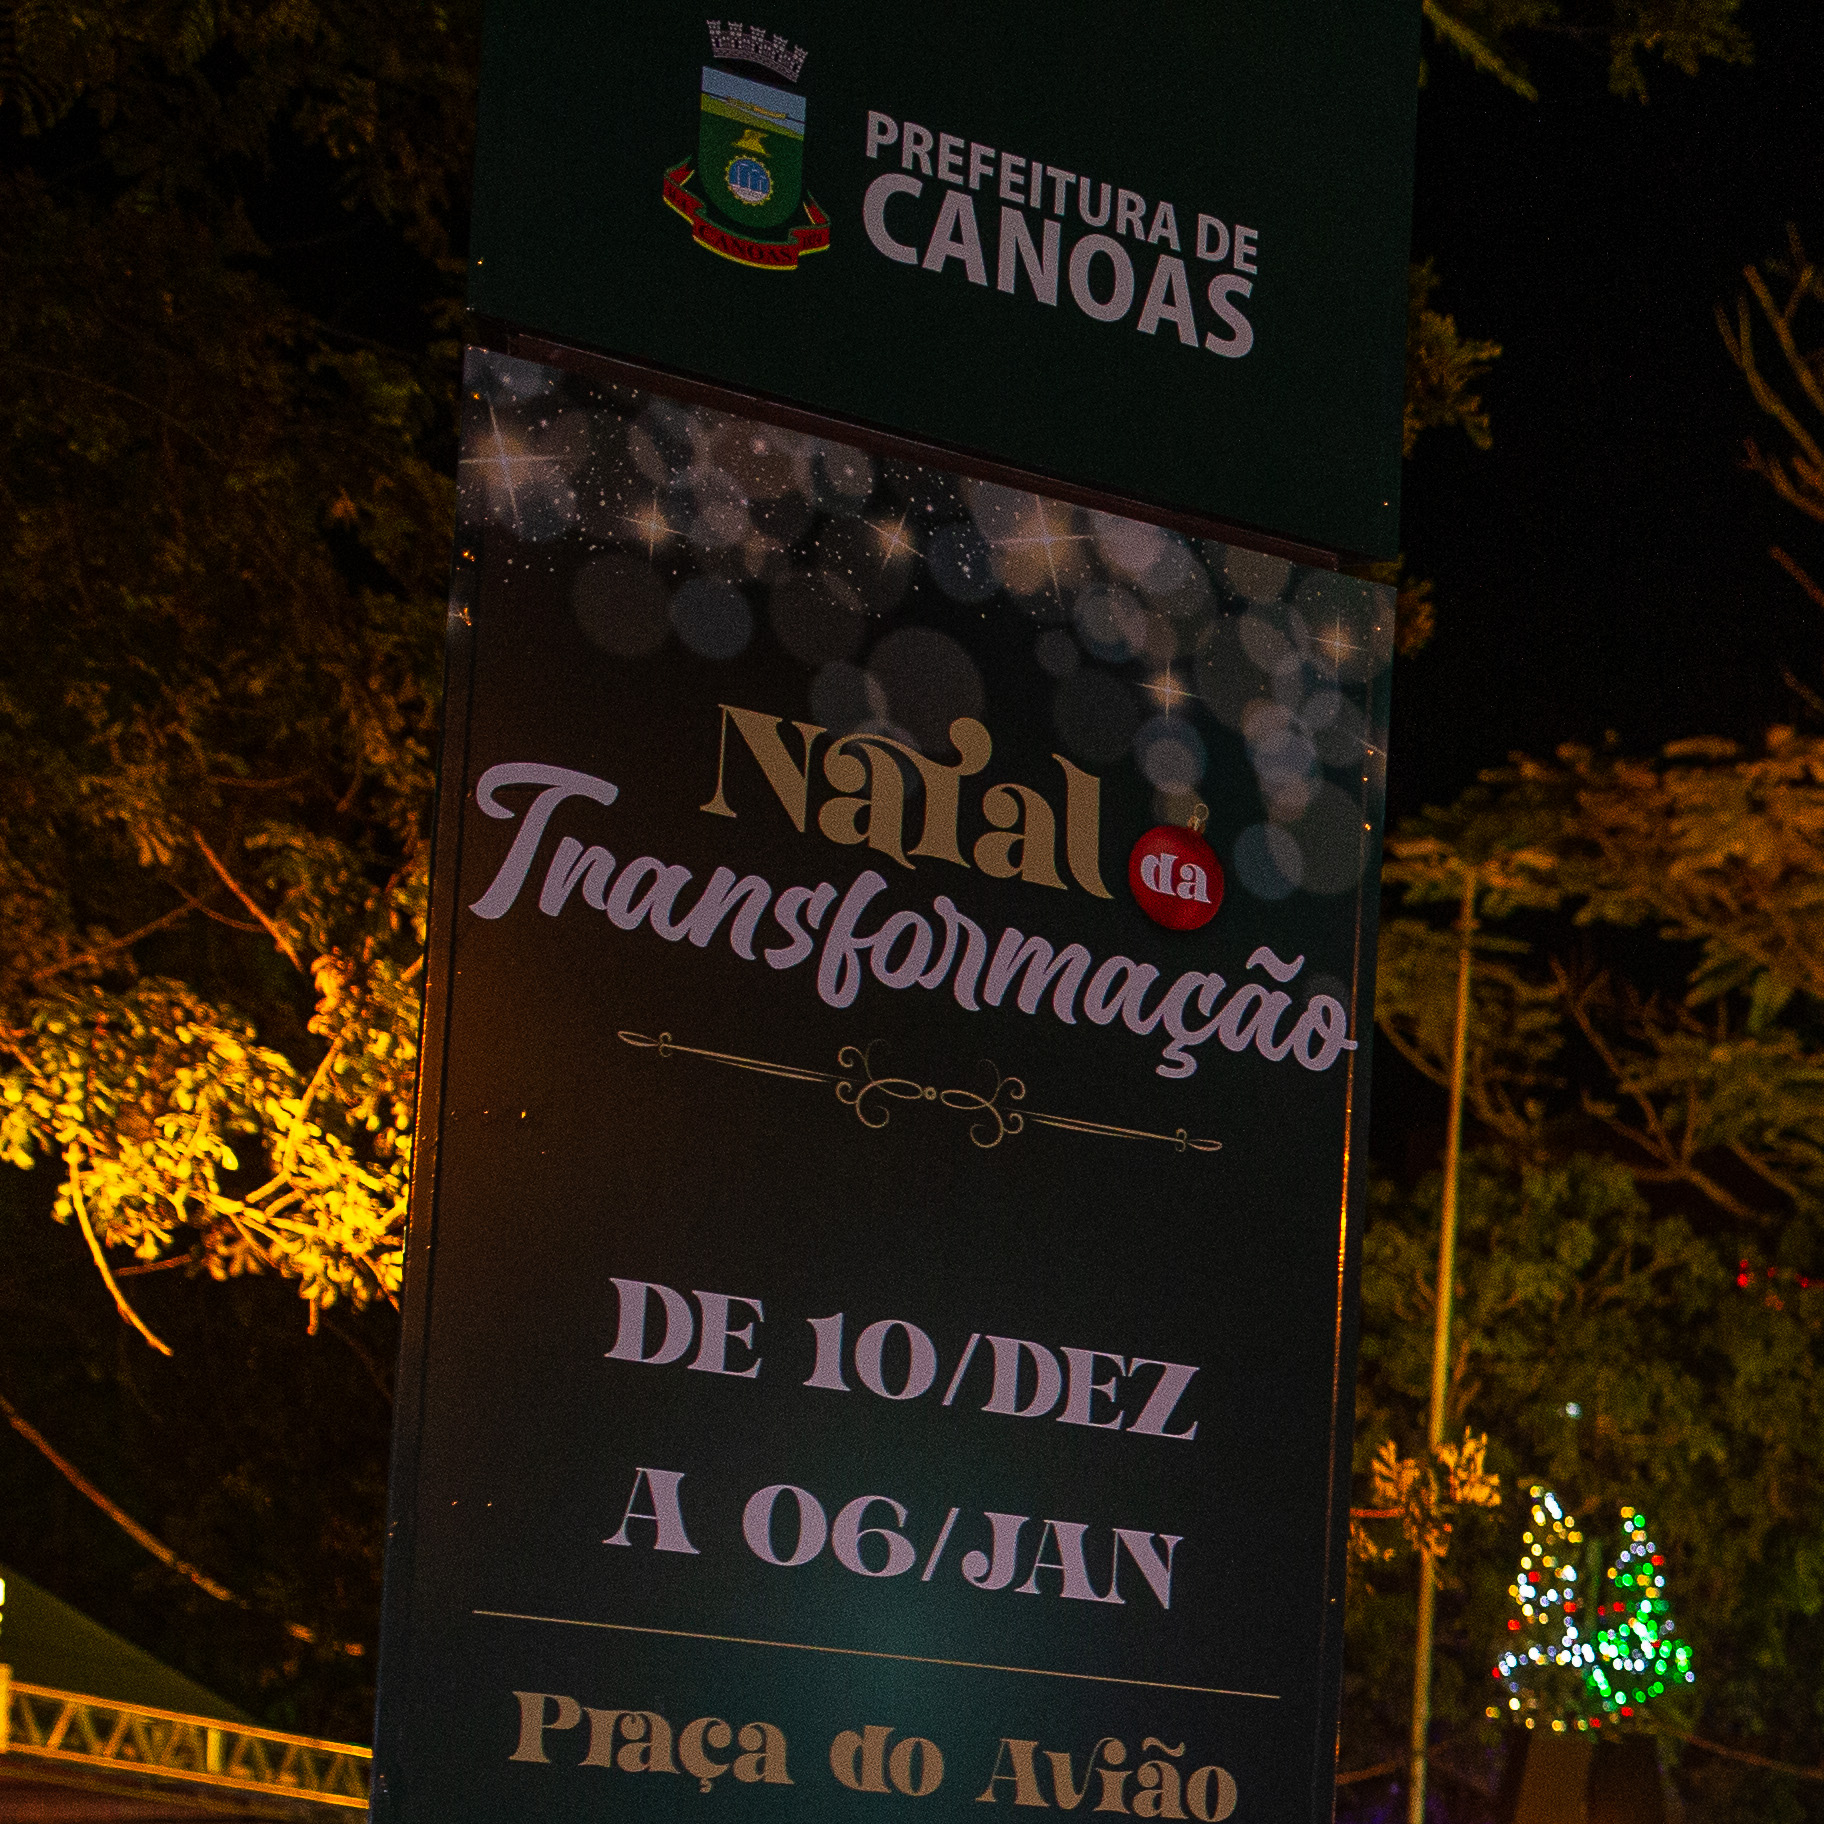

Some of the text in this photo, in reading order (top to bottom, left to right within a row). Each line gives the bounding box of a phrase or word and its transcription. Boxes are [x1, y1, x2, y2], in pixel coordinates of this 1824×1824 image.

[861, 172, 1255, 359] CANOAS
[865, 109, 1259, 276] PREFEITURA DE
[699, 702, 1212, 905] Natal da
[468, 761, 1359, 1080] Transformação
[603, 1276, 1201, 1441] DE 10/DEZ
[601, 1466, 1184, 1610] A 06/JAN
[508, 1690, 1239, 1824] Praça do Avião
